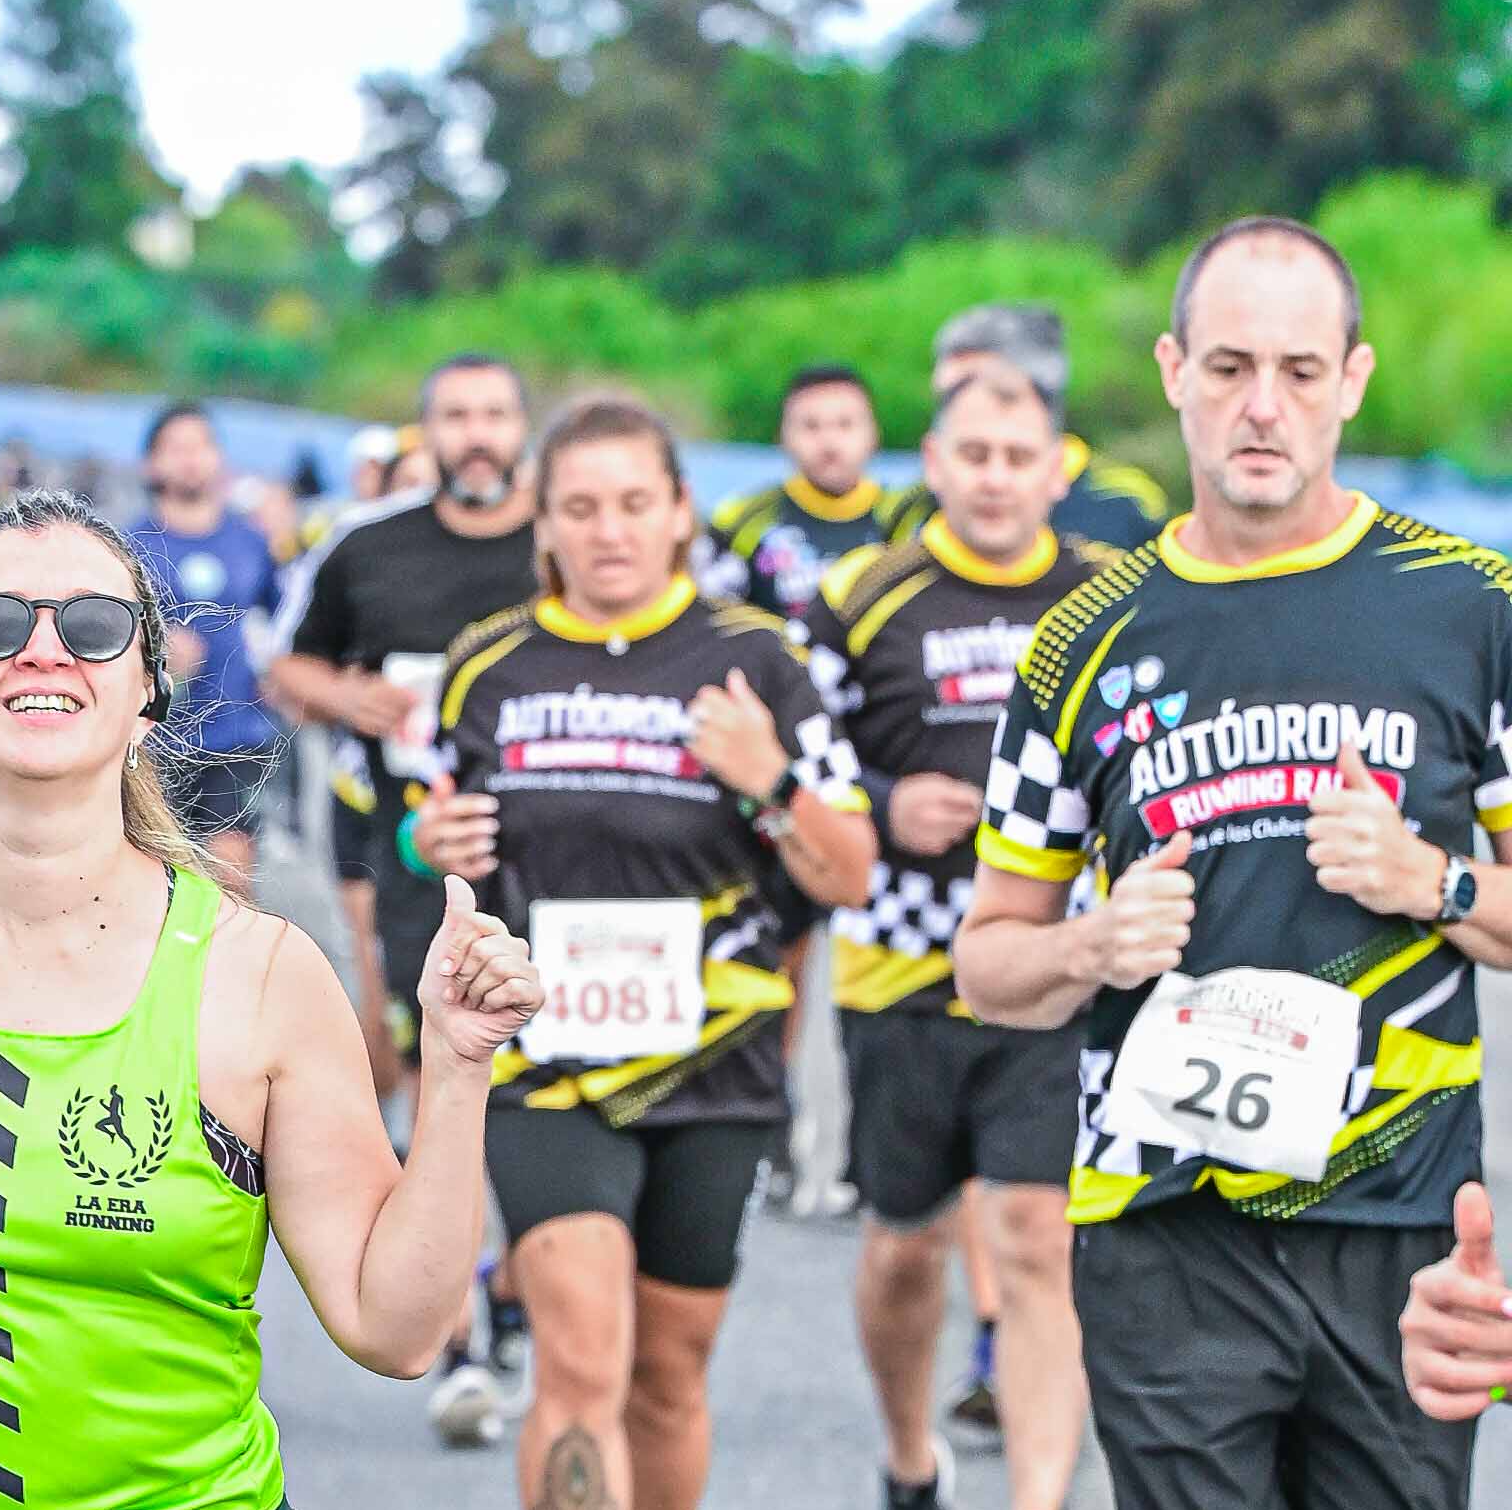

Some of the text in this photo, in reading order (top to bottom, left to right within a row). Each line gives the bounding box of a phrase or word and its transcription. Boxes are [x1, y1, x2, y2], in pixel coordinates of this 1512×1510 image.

[1129, 697, 1419, 806] AUTÓDROMO
[1169, 767, 1288, 829] RUNNING
[541, 976, 683, 1027] 4081
[1172, 1057, 1273, 1131] 26
[65, 1211, 155, 1233] RUNNING
[75, 1195, 147, 1215] LA ERA
